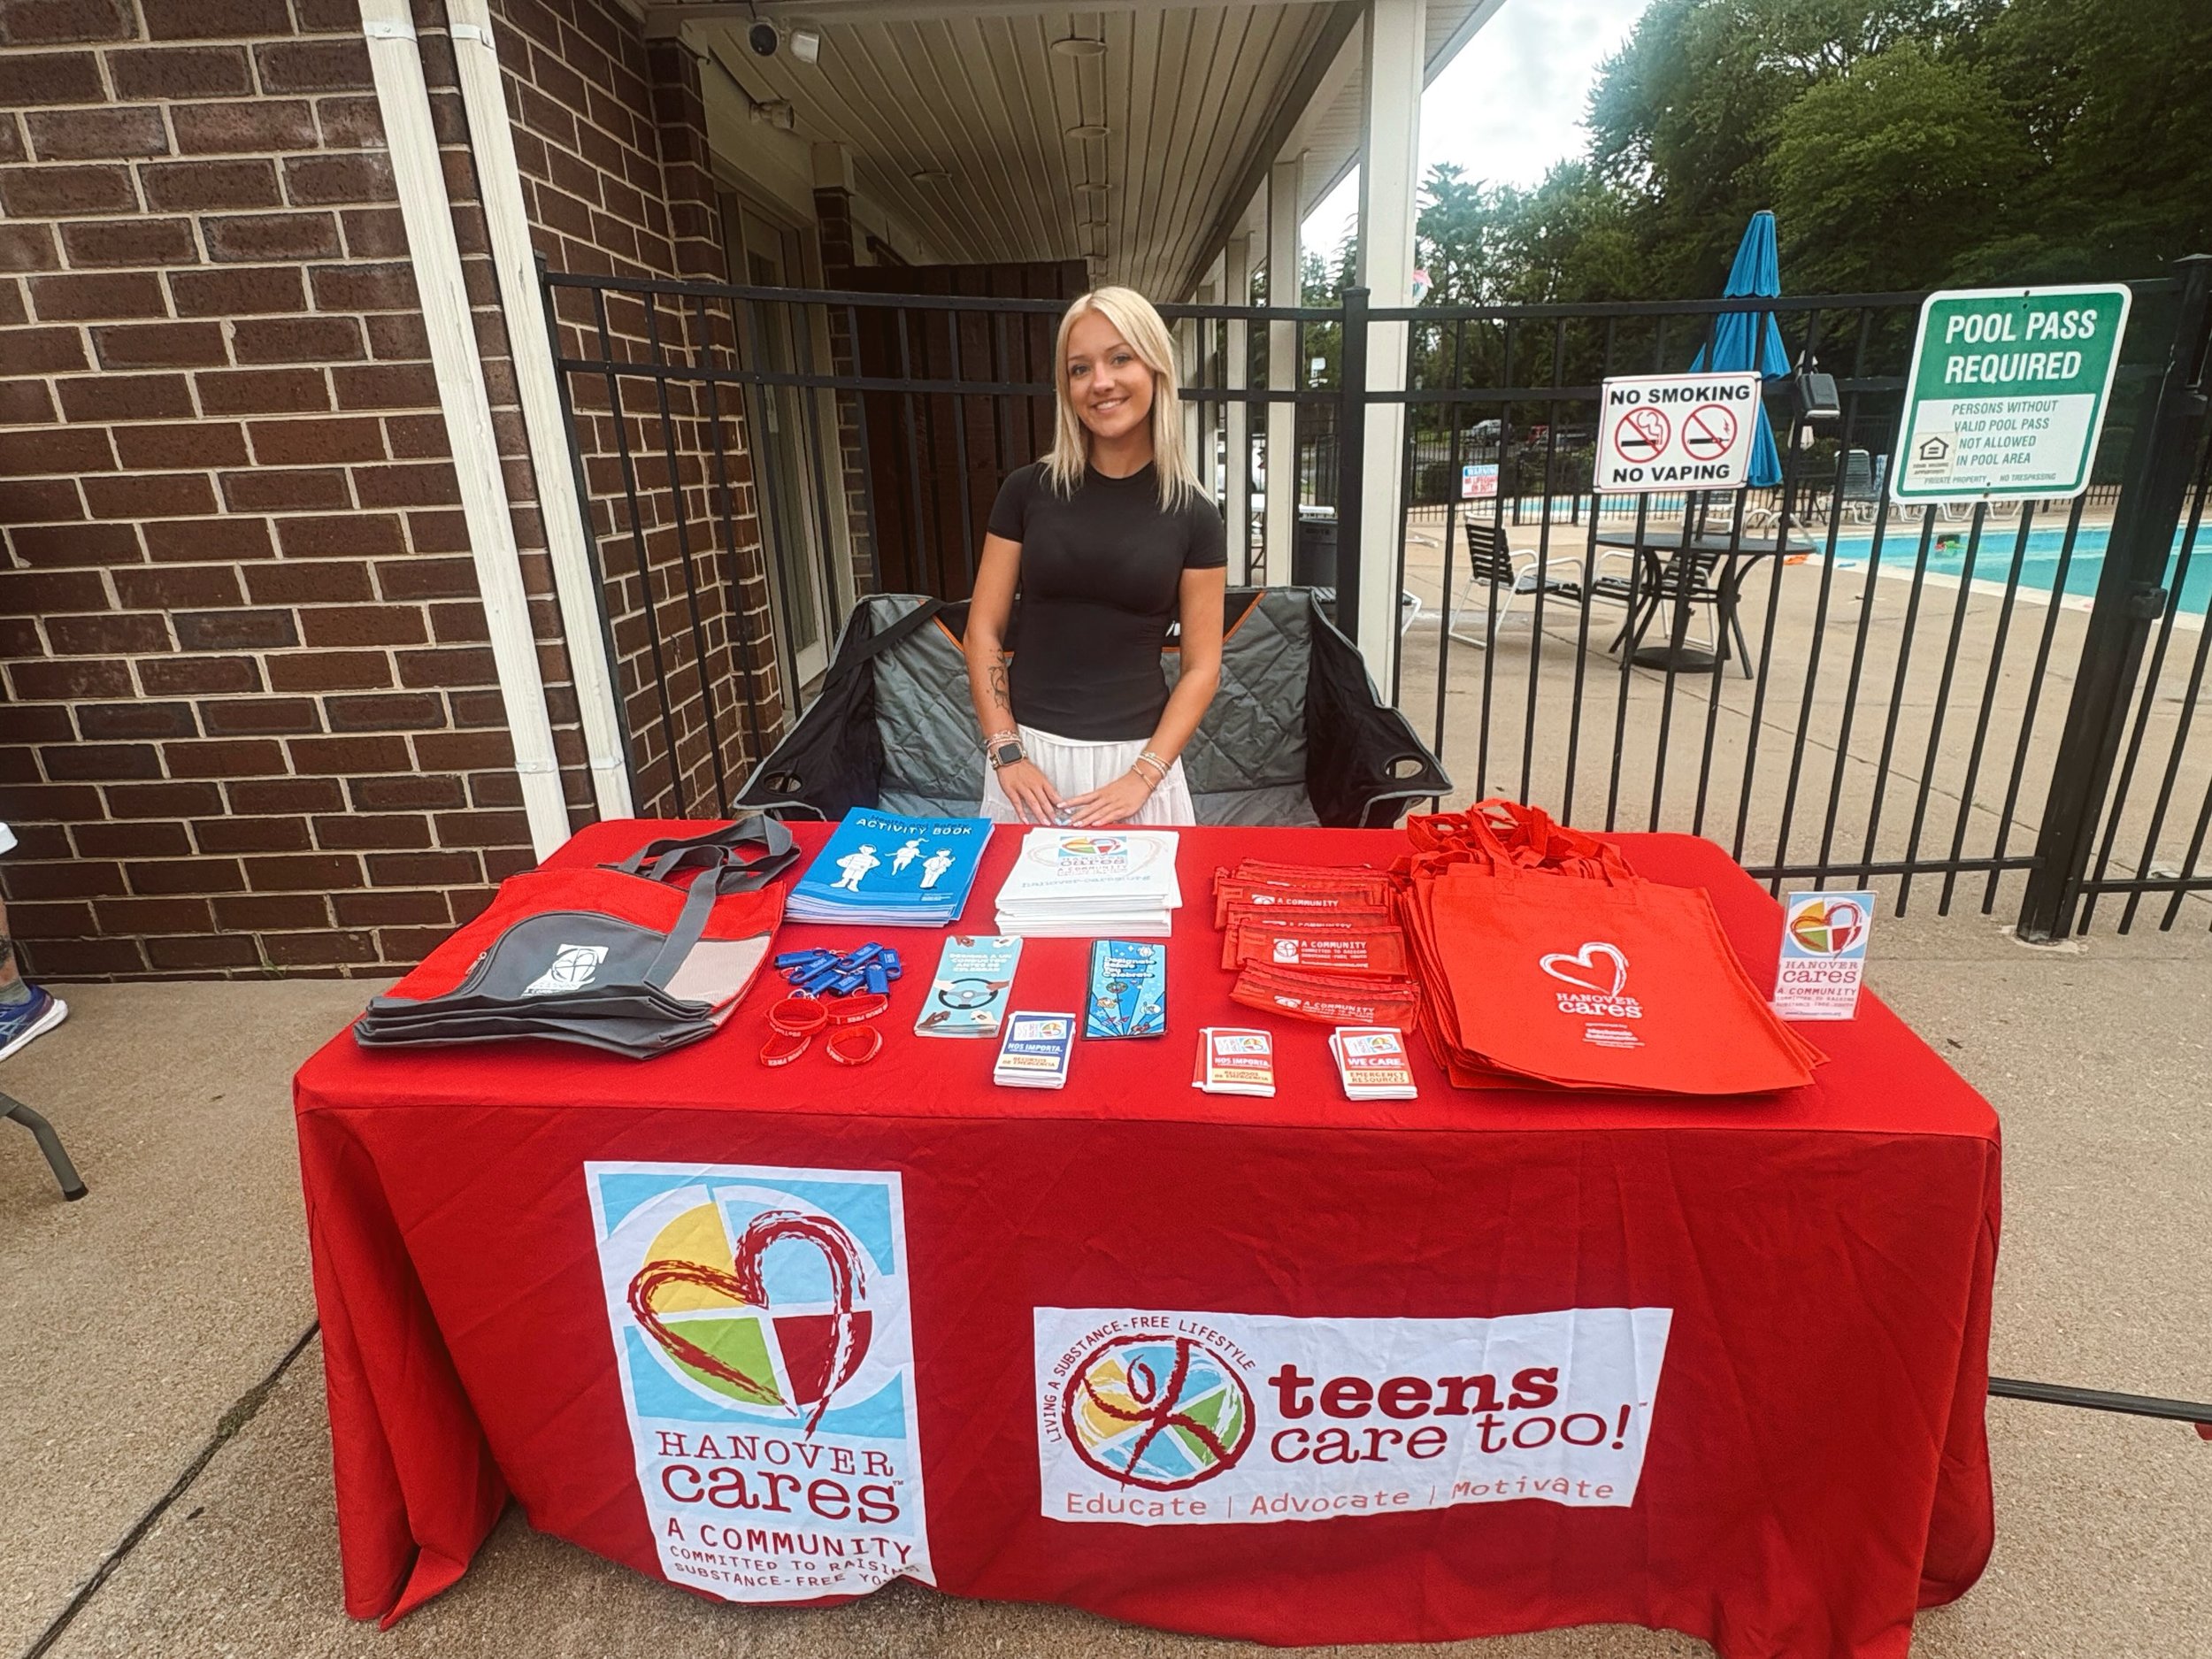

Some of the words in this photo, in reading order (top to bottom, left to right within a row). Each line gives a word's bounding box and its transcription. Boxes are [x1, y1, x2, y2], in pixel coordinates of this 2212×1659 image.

[1945, 313, 2017, 344] POOL
[2025, 310, 2098, 341] PASS
[1945, 351, 2082, 384] REQUIRED
[1610, 390, 1641, 405] NO
[1647, 385, 1750, 403] SMOKING
[1952, 402, 2004, 416] PERSONS
[2007, 400, 2058, 413] WITHOUT
[1954, 420, 1986, 433] VALID
[1991, 419, 2017, 431] POOL
[2021, 418, 2050, 430] PASS
[1959, 437, 1982, 449] NOT
[1984, 435, 2037, 449] ALLOWED
[1956, 456, 1969, 466] IN
[1970, 454, 1999, 466] POOL
[2001, 452, 2032, 465] AREA
[1613, 468, 1644, 483] NO
[1651, 464, 1731, 481] VAPING
[856, 818, 927, 835] ACTIVITY
[1286, 898, 1339, 907] COMMUNITY
[1310, 941, 1367, 949] COMMUNITY
[1785, 961, 1859, 970] HANOVER
[1782, 970, 1856, 984] cares
[1313, 1002, 1375, 1013] COMMUNITY
[1555, 992, 1640, 1006] HANOVER
[1558, 1001, 1643, 1018] cares
[1348, 1057, 1367, 1066] WE
[1369, 1057, 1405, 1066] CARE.
[1054, 1317, 1171, 1377] SUBSTANCE-FREE
[1179, 1319, 1256, 1371] LIFESTYLE
[1048, 1381, 1061, 1390] A
[1268, 1363, 1559, 1419] teens
[1043, 1394, 1062, 1443] LIVING
[1271, 1425, 1448, 1465] care
[1477, 1404, 1632, 1454] too!
[656, 1431, 894, 1477] HANOVER
[662, 1464, 901, 1525] cares
[1067, 1492, 1208, 1517] Educate
[1249, 1490, 1409, 1516] Advocate
[1451, 1476, 1614, 1500] Motivate
[667, 1517, 685, 1542] A
[700, 1524, 912, 1565] COMMUNITY
[670, 1545, 778, 1571] COMMITTED
[791, 1560, 816, 1571] TO
[674, 1563, 846, 1586] SUBSTANCE-FREE
